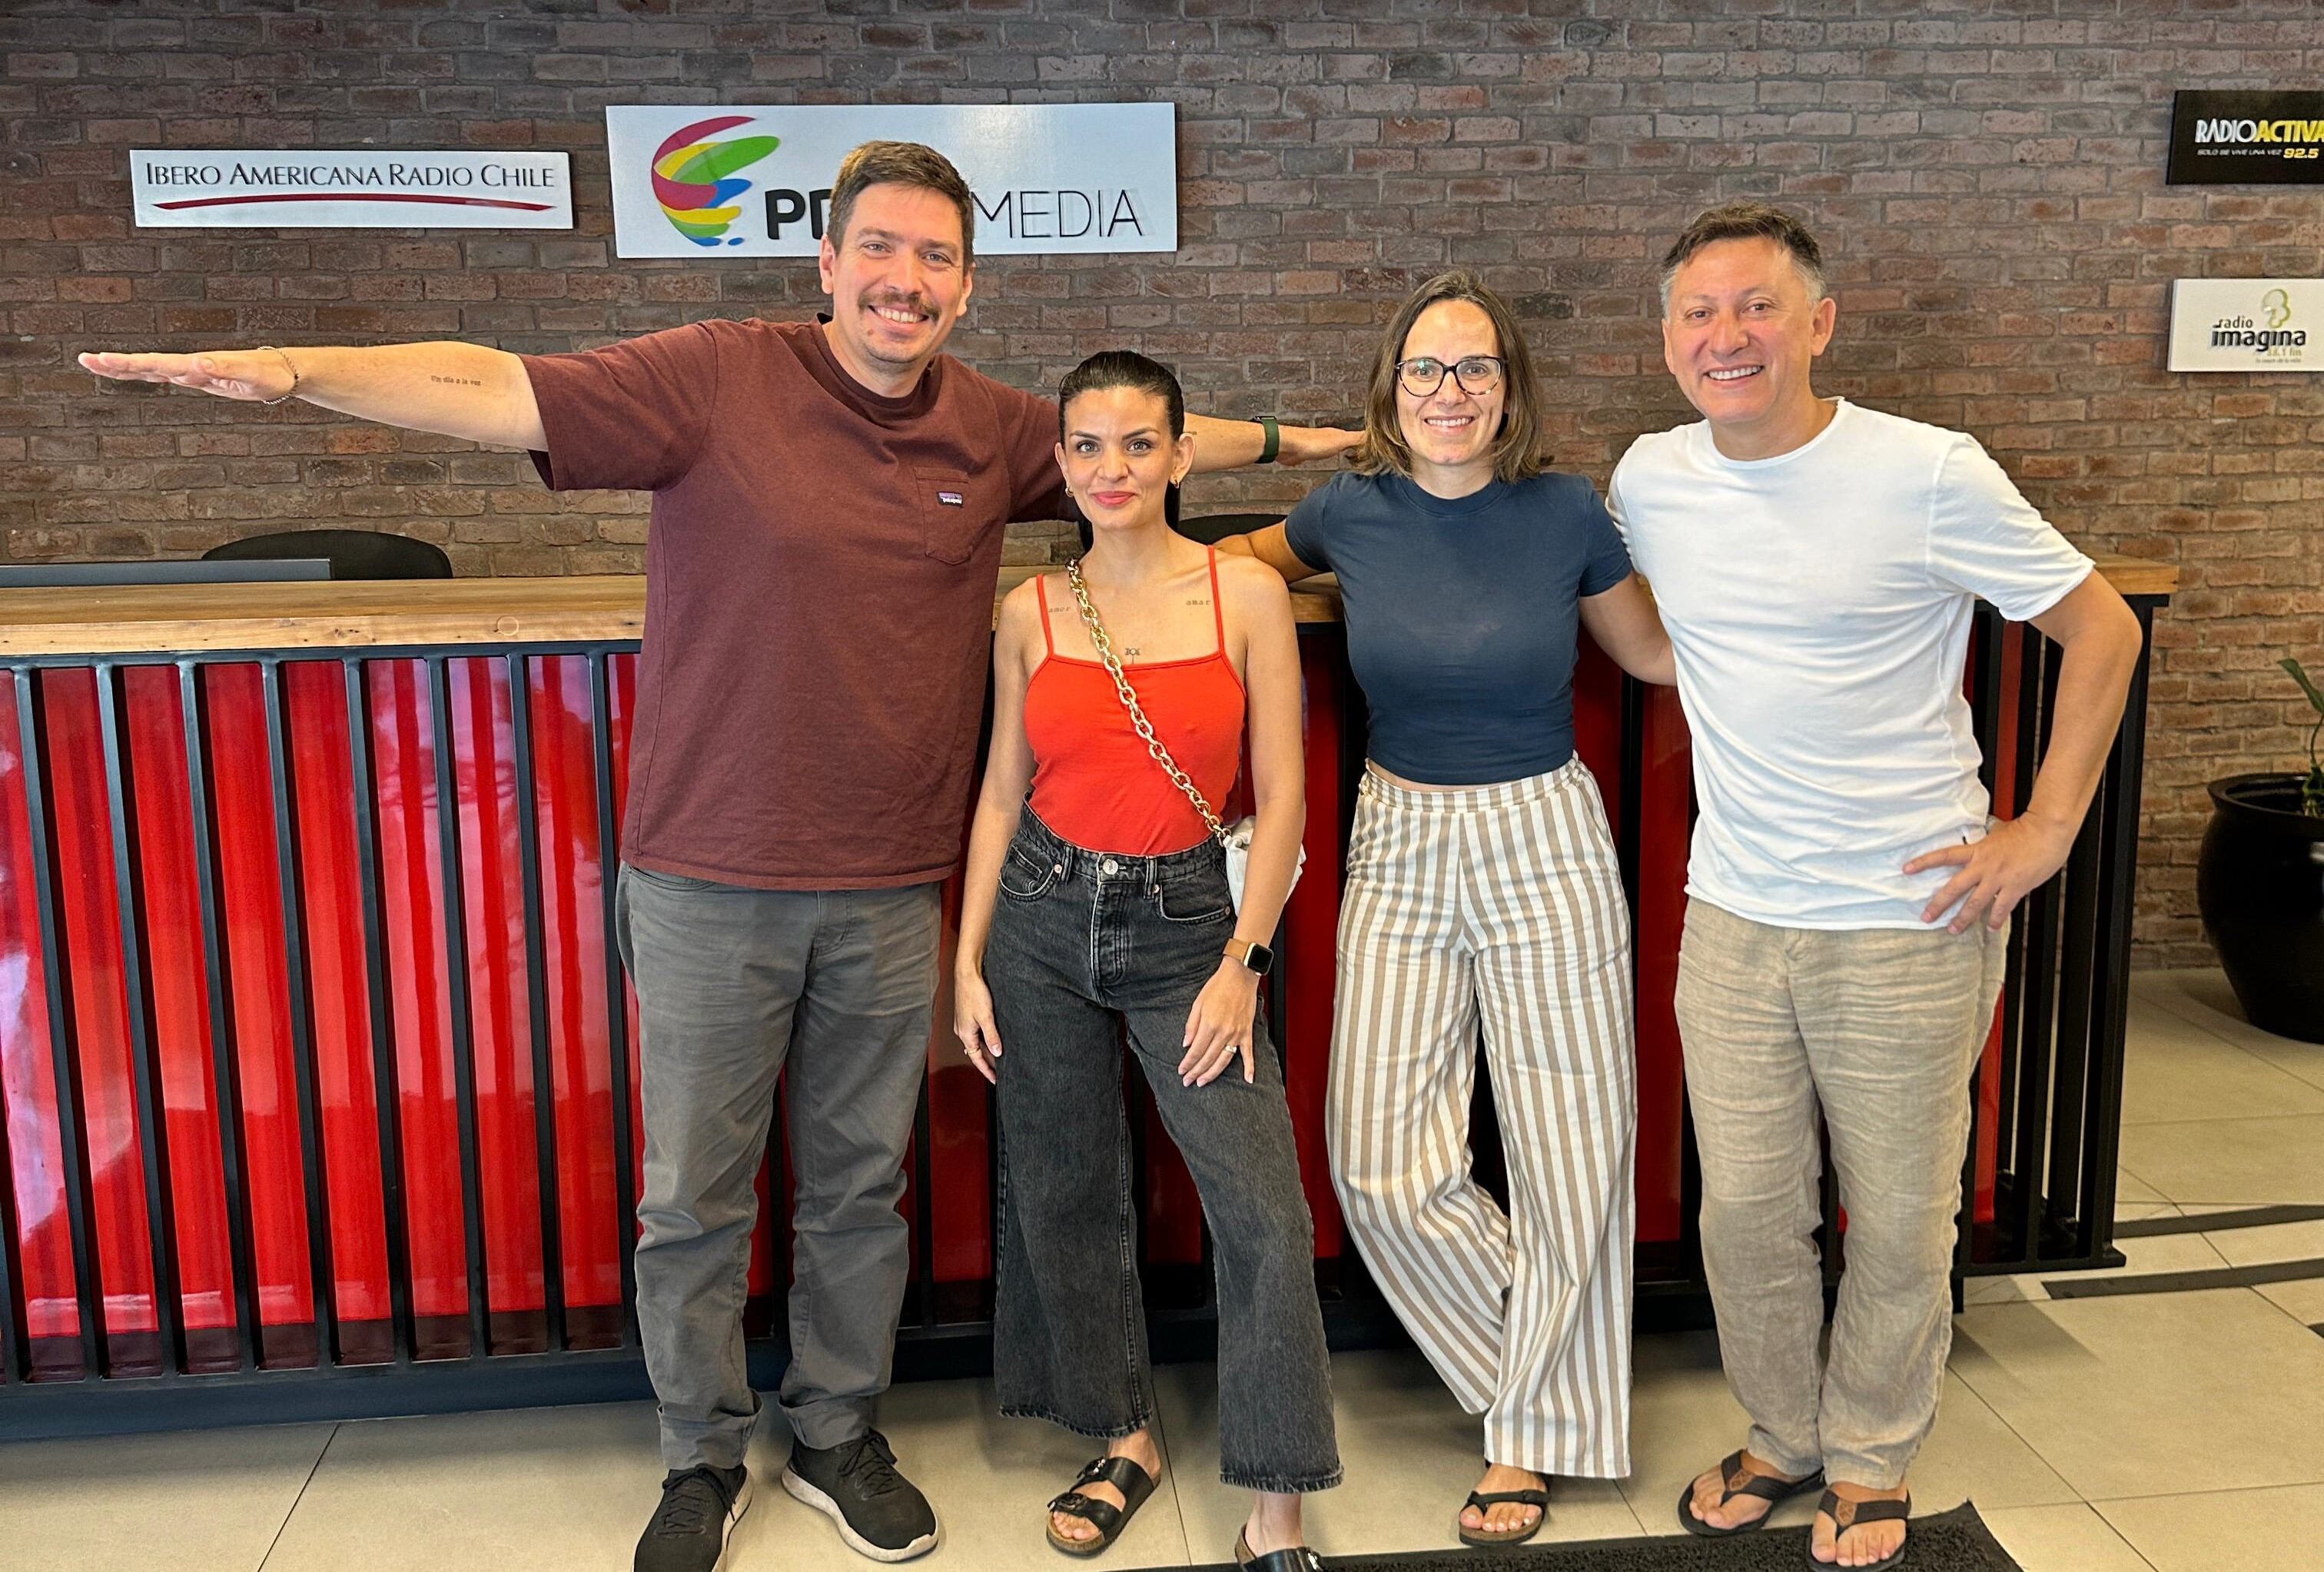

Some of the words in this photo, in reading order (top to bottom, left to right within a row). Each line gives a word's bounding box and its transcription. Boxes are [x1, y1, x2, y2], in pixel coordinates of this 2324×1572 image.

[2283, 148, 2319, 159] 92.5
[146, 162, 222, 185] IBERO
[229, 162, 383, 186] AMERICANA
[389, 164, 473, 186] RADIO
[480, 164, 555, 187] CHILE
[970, 189, 1143, 238] MEDIA
[2213, 315, 2253, 328] radio
[2211, 330, 2306, 352] imagina
